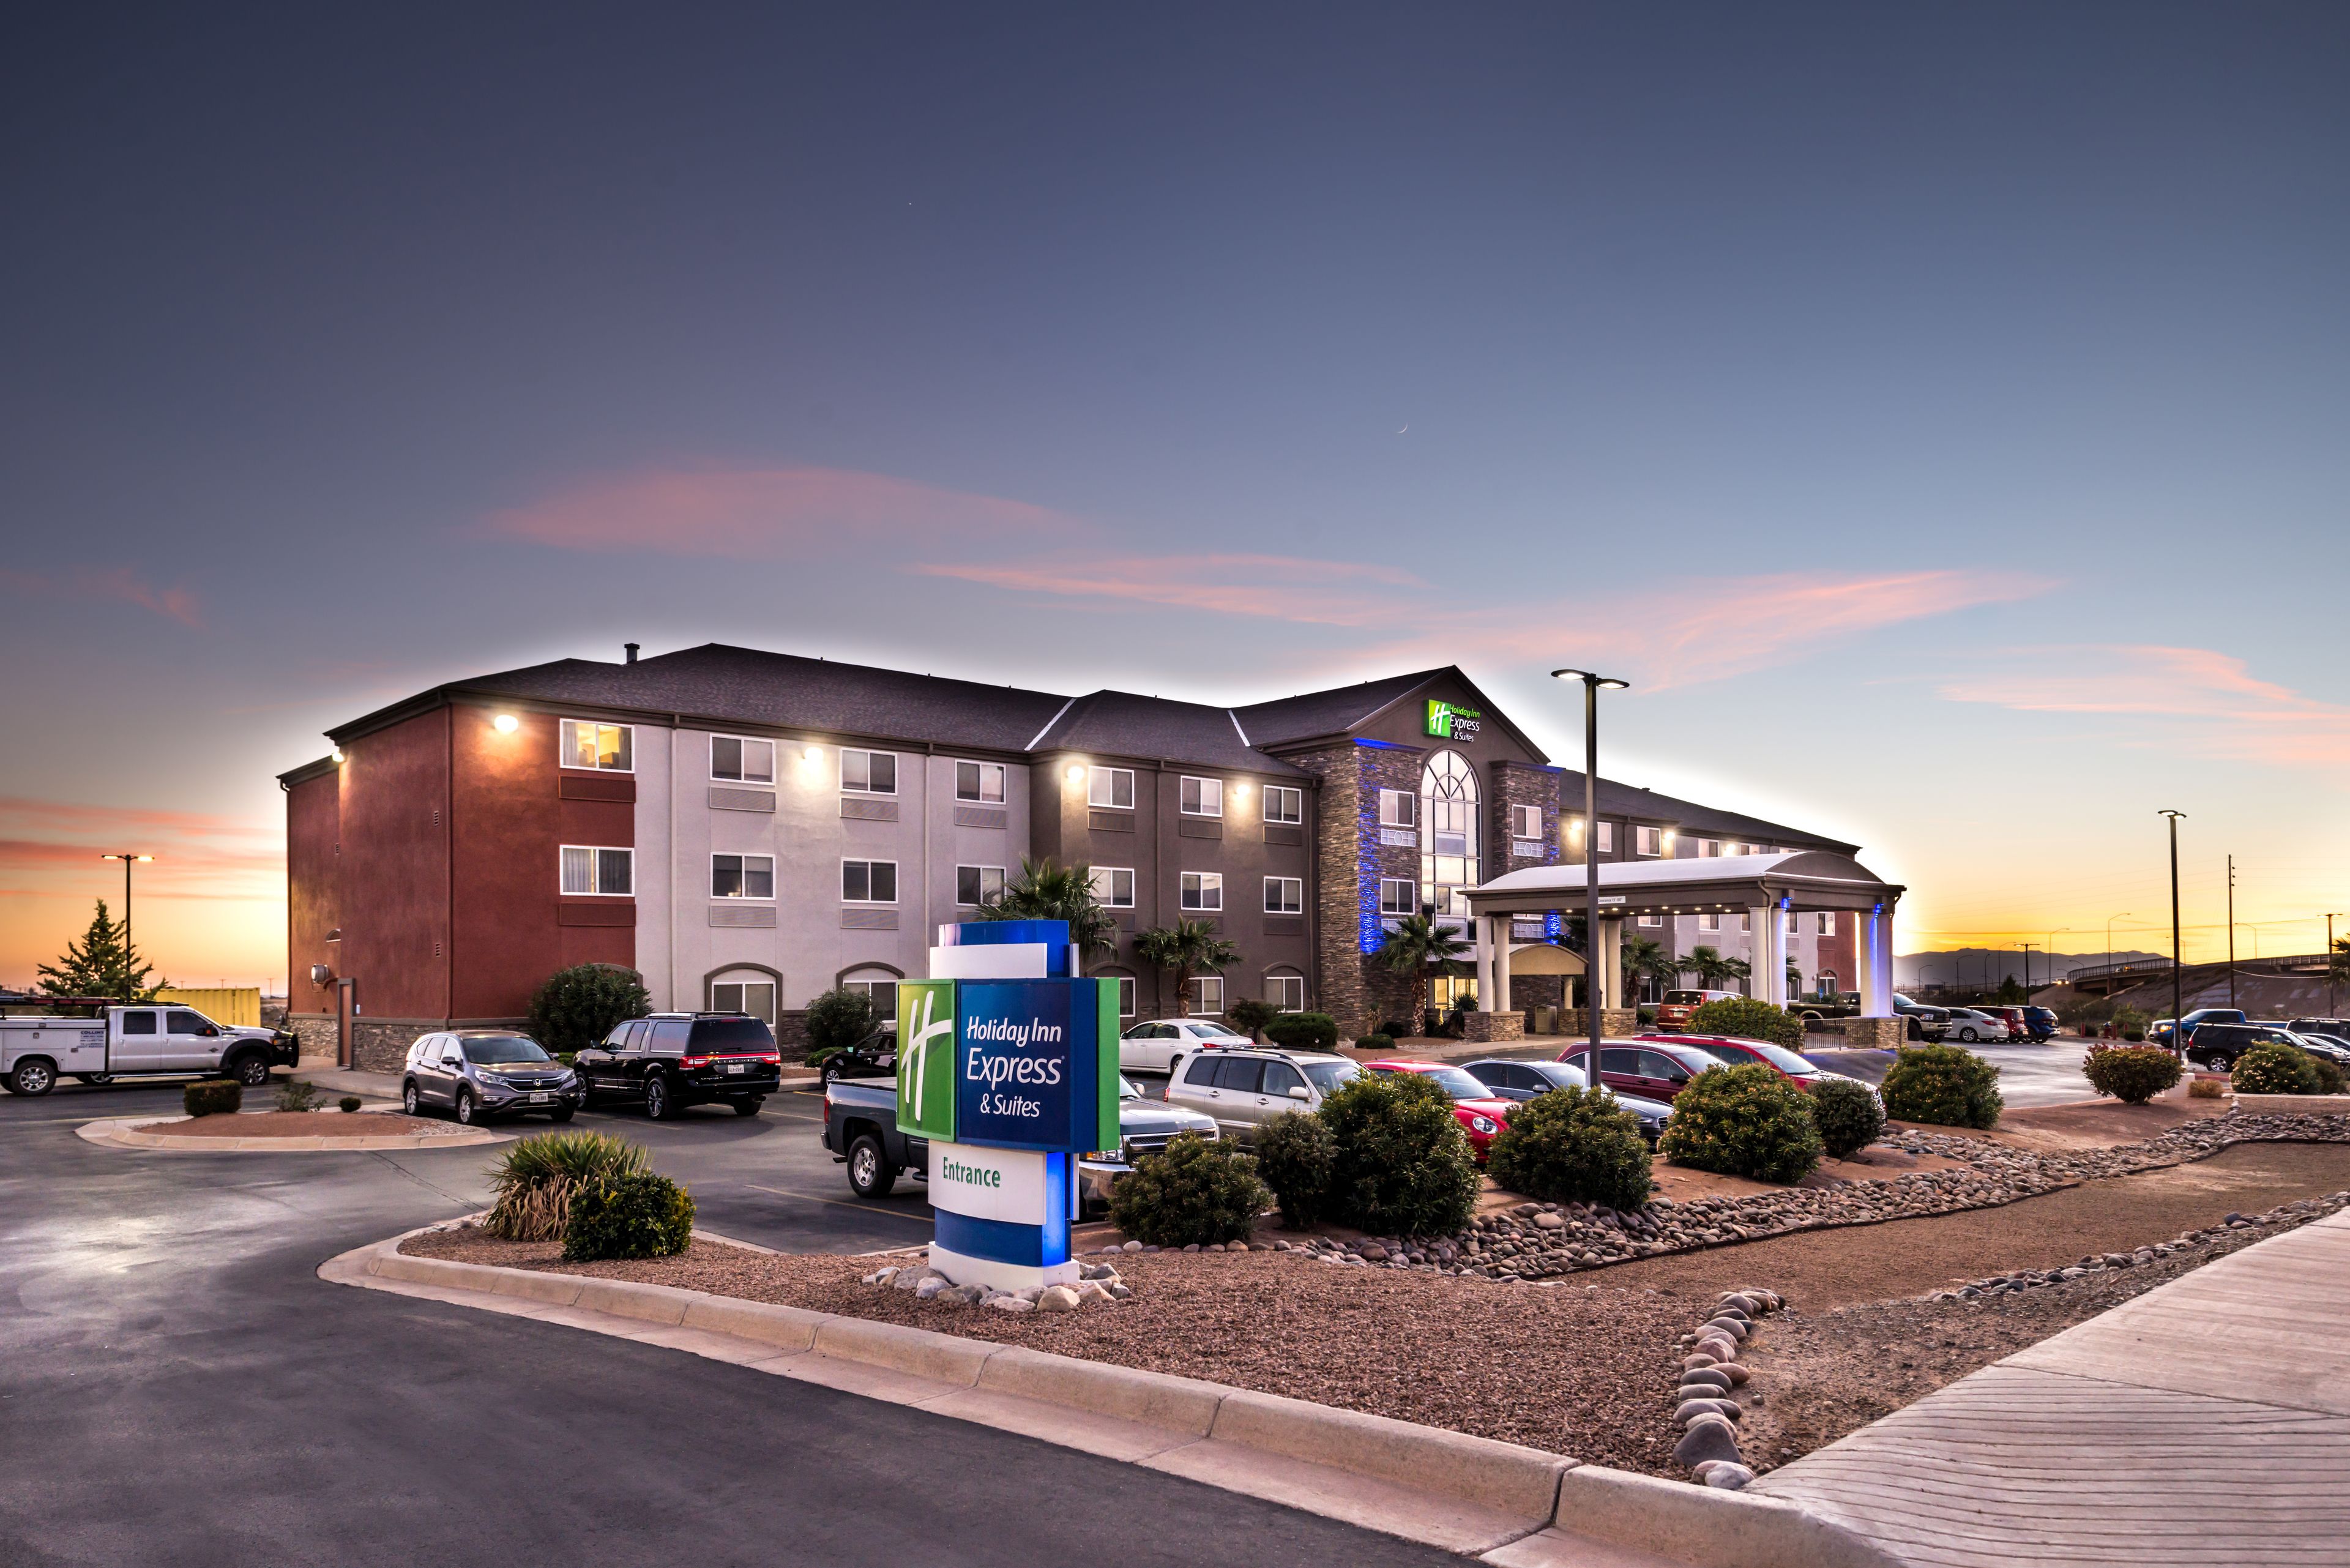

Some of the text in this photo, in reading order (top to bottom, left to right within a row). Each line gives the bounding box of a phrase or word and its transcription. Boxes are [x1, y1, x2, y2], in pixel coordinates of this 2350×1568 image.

[1450, 704, 1480, 719] Holiday Inn
[1450, 714, 1480, 731] Express
[1459, 732, 1474, 742] Suites
[966, 1016, 1062, 1047] Holiday Inn
[966, 1047, 1062, 1091] Express
[980, 1093, 1040, 1118] & Suites
[943, 1156, 1001, 1188] Entrance
